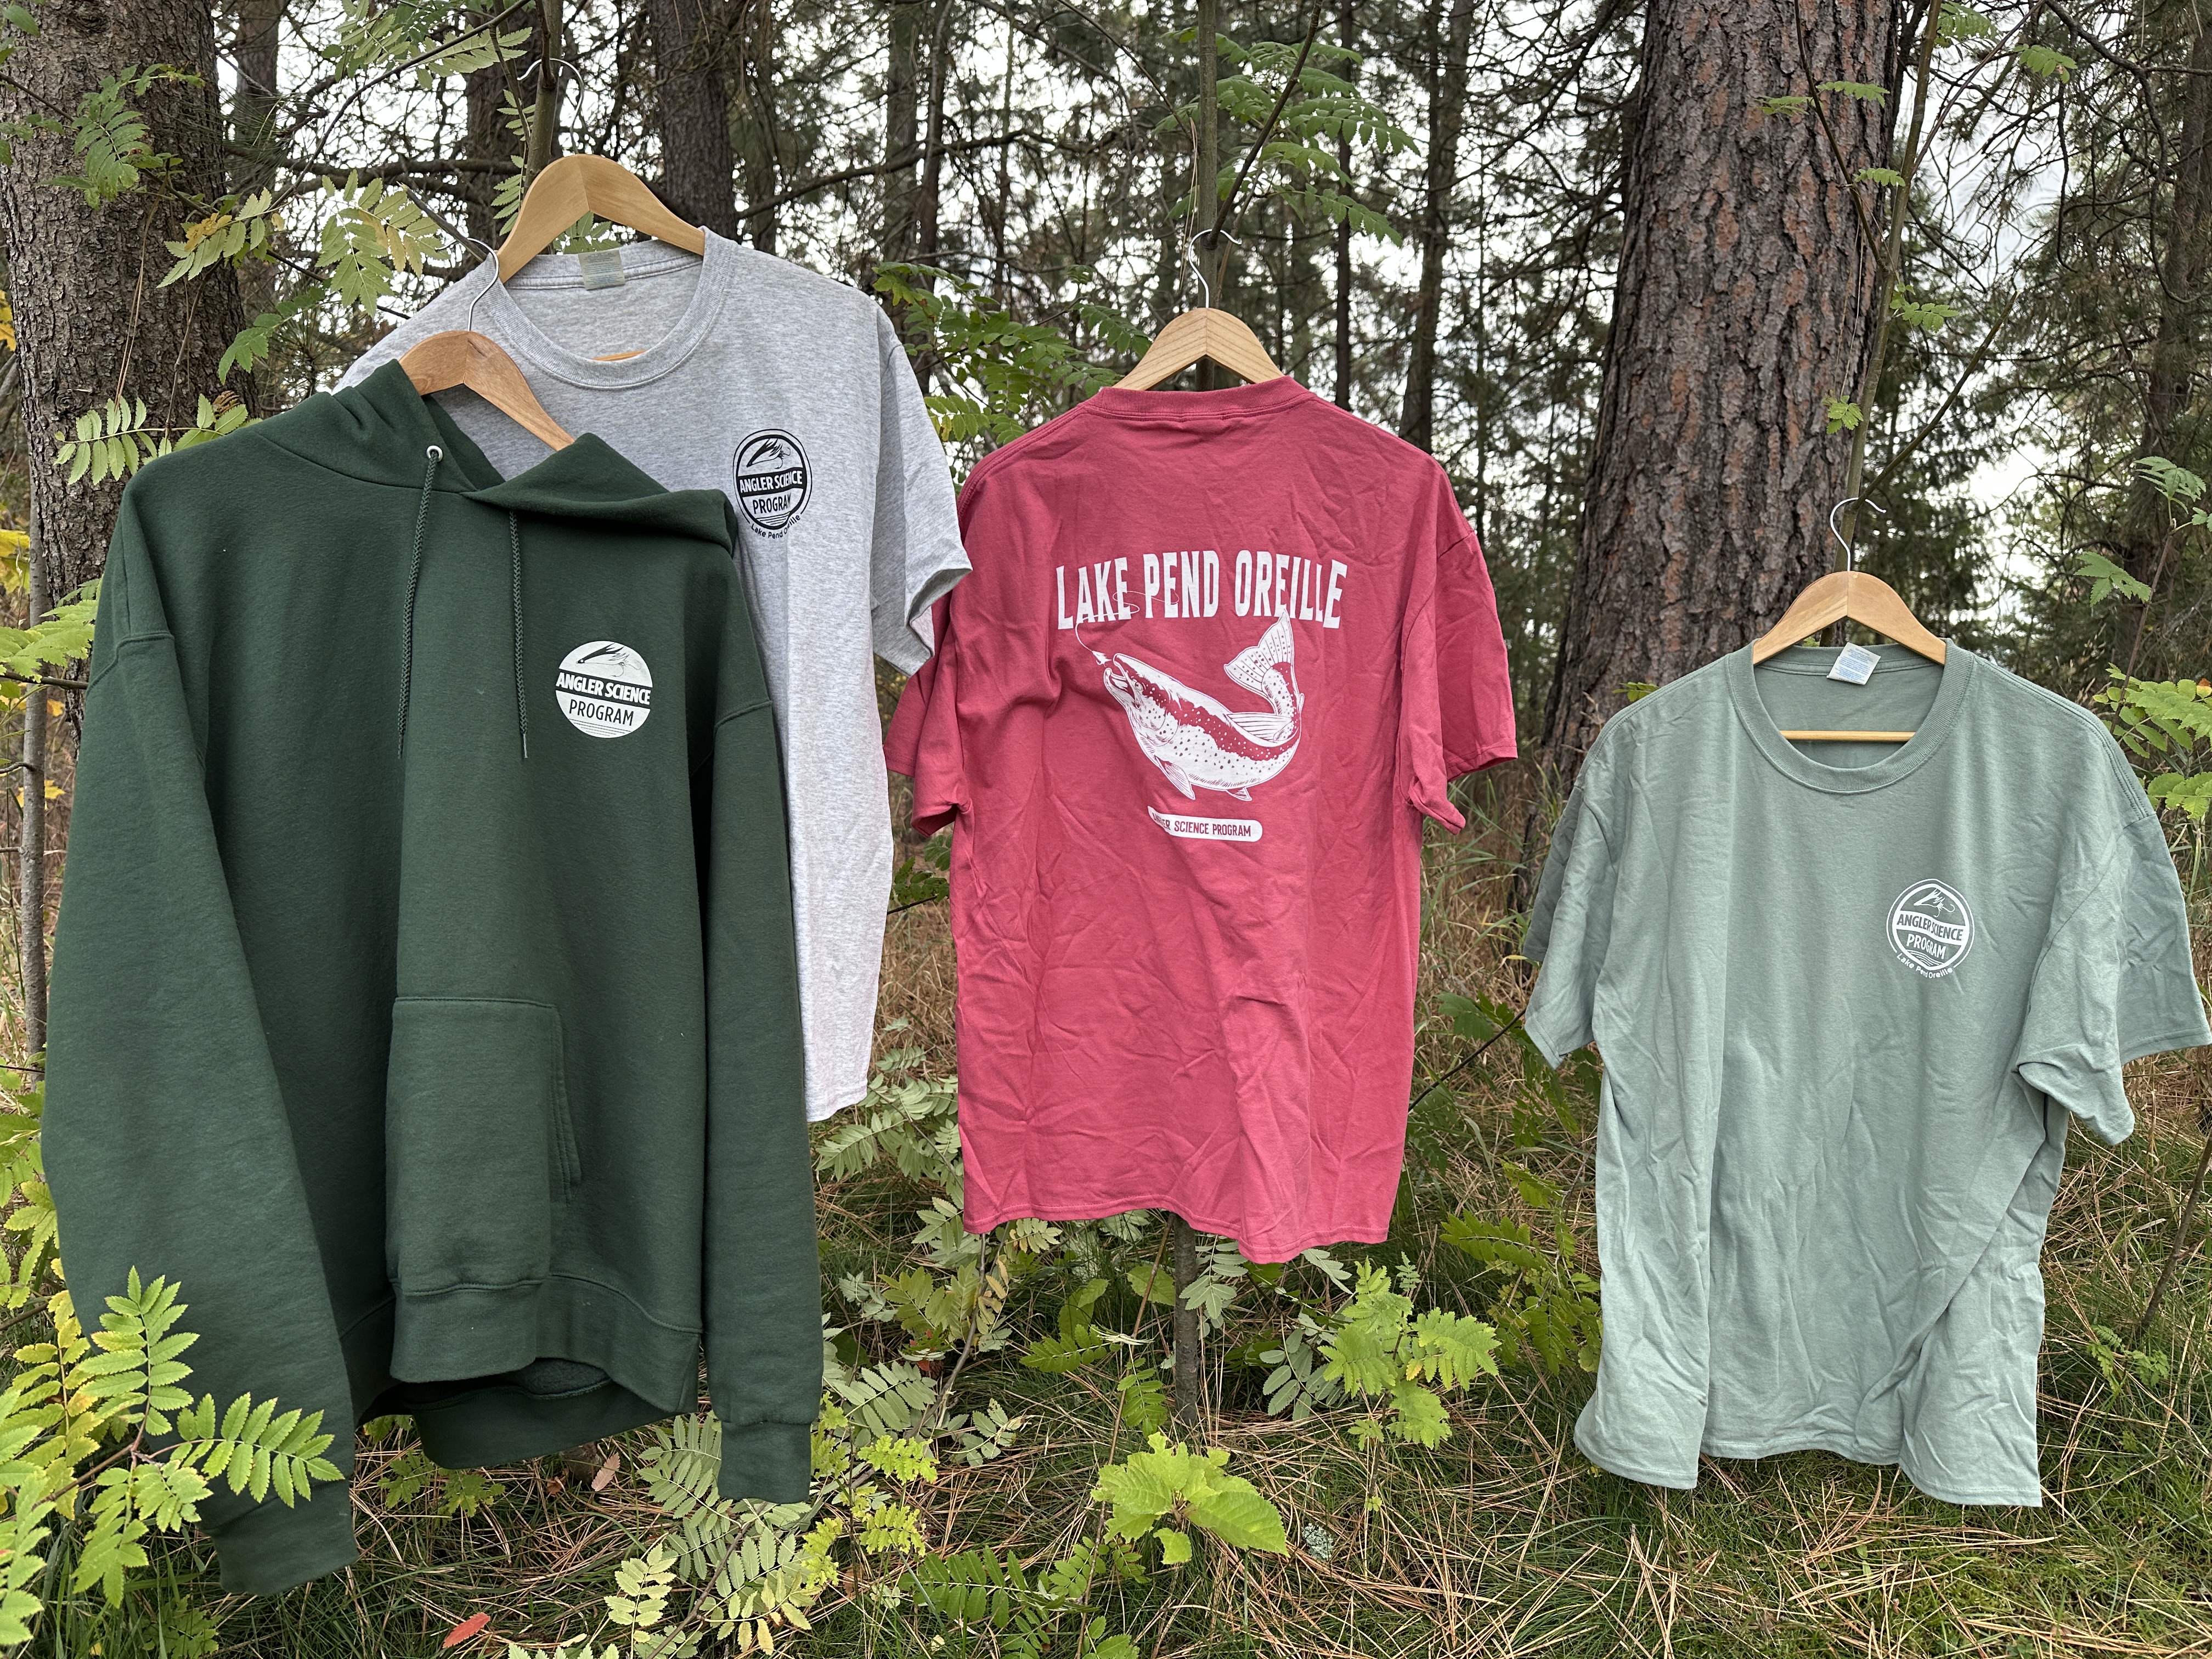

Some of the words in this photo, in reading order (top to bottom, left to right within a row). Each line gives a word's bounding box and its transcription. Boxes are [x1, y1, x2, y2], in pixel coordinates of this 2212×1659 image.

[740, 476, 774, 493] ANGLER
[774, 471, 803, 489] SCIENCE
[751, 523, 766, 537] Lake
[768, 530, 783, 539] Pend
[783, 515, 800, 534] Oille
[1056, 557, 1131, 630] LAKE
[1143, 550, 1220, 618] PEND
[1235, 550, 1347, 629] OREILLE
[555, 672, 604, 696] ANGLER
[605, 682, 651, 705] SCIENCE
[569, 699, 634, 726] PROGRAM
[1174, 821, 1209, 834] SCIENCE
[1212, 823, 1251, 837] PROGRAM
[1897, 913, 1932, 931] ANGLER
[1931, 922, 1963, 941] SCIENCE
[1906, 933, 1946, 960] PROGRAM
[1897, 952, 1915, 969] Lake
[1928, 967, 1953, 979] Oreille
